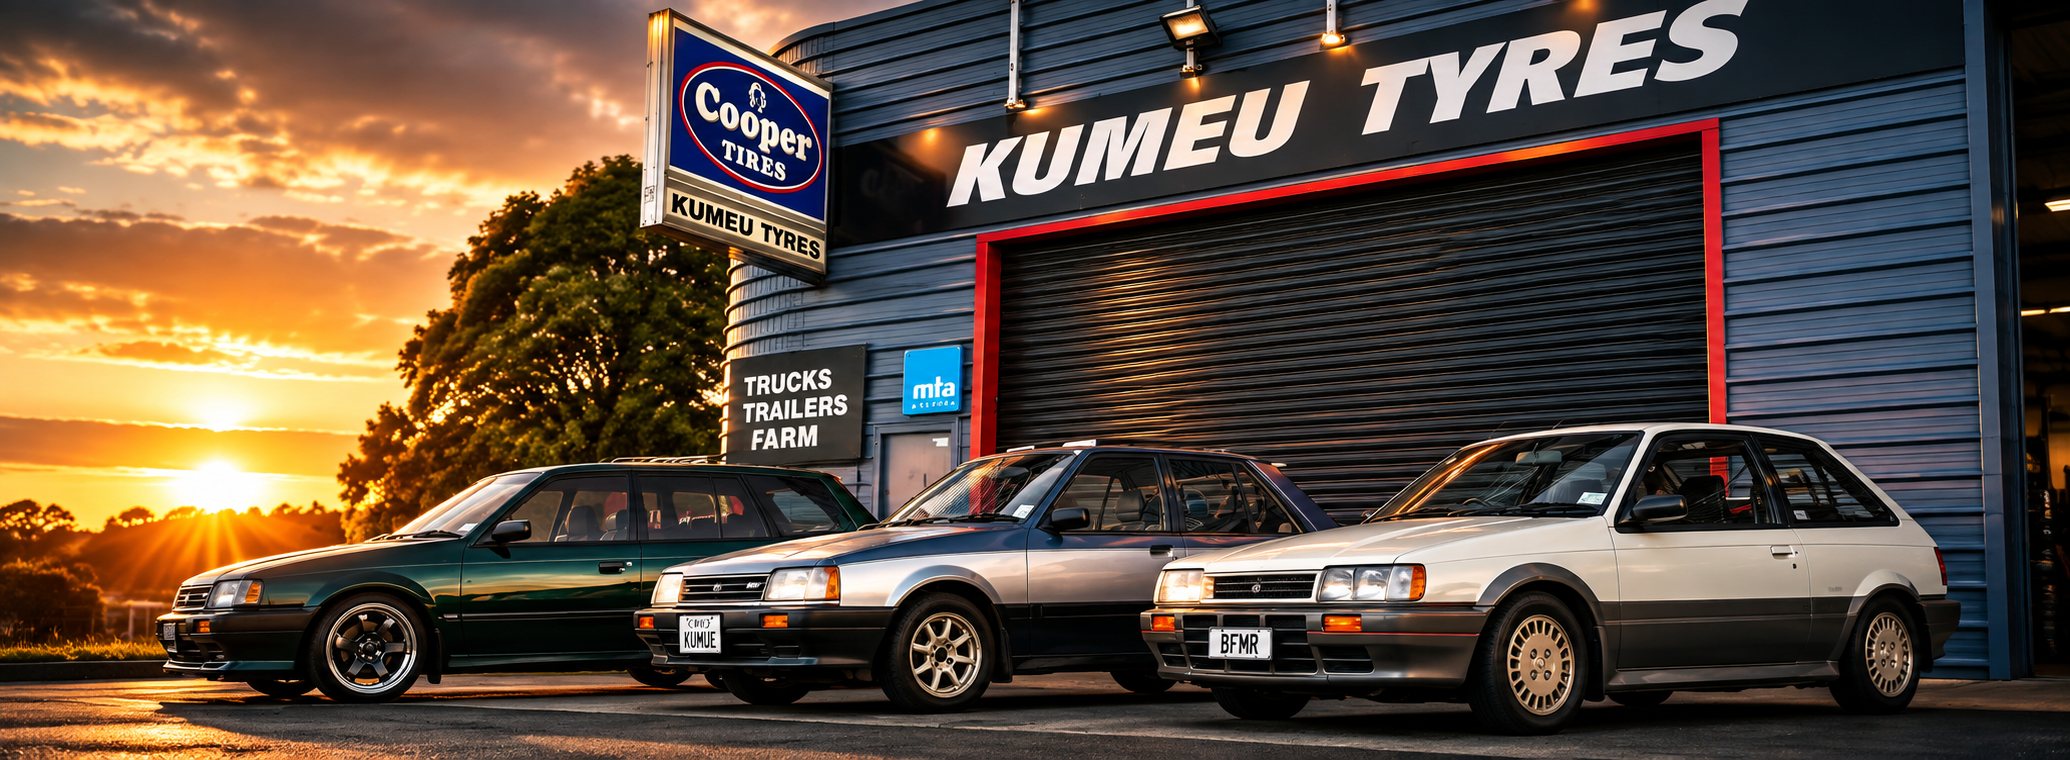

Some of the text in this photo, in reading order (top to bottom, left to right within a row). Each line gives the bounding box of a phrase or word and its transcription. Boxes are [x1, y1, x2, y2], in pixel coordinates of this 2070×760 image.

[946, 0, 1749, 207] KUMEU TYRES
[695, 81, 812, 162] Cooper
[721, 138, 787, 182] TIRES
[671, 193, 821, 260] KUMEU TYRES
[744, 368, 832, 397] TRUCKS
[912, 375, 956, 400] mta
[743, 394, 848, 423] TRAILERS
[751, 424, 818, 450] FARM
[684, 631, 717, 648] KUMUE
[1220, 632, 1259, 655] BFMR
